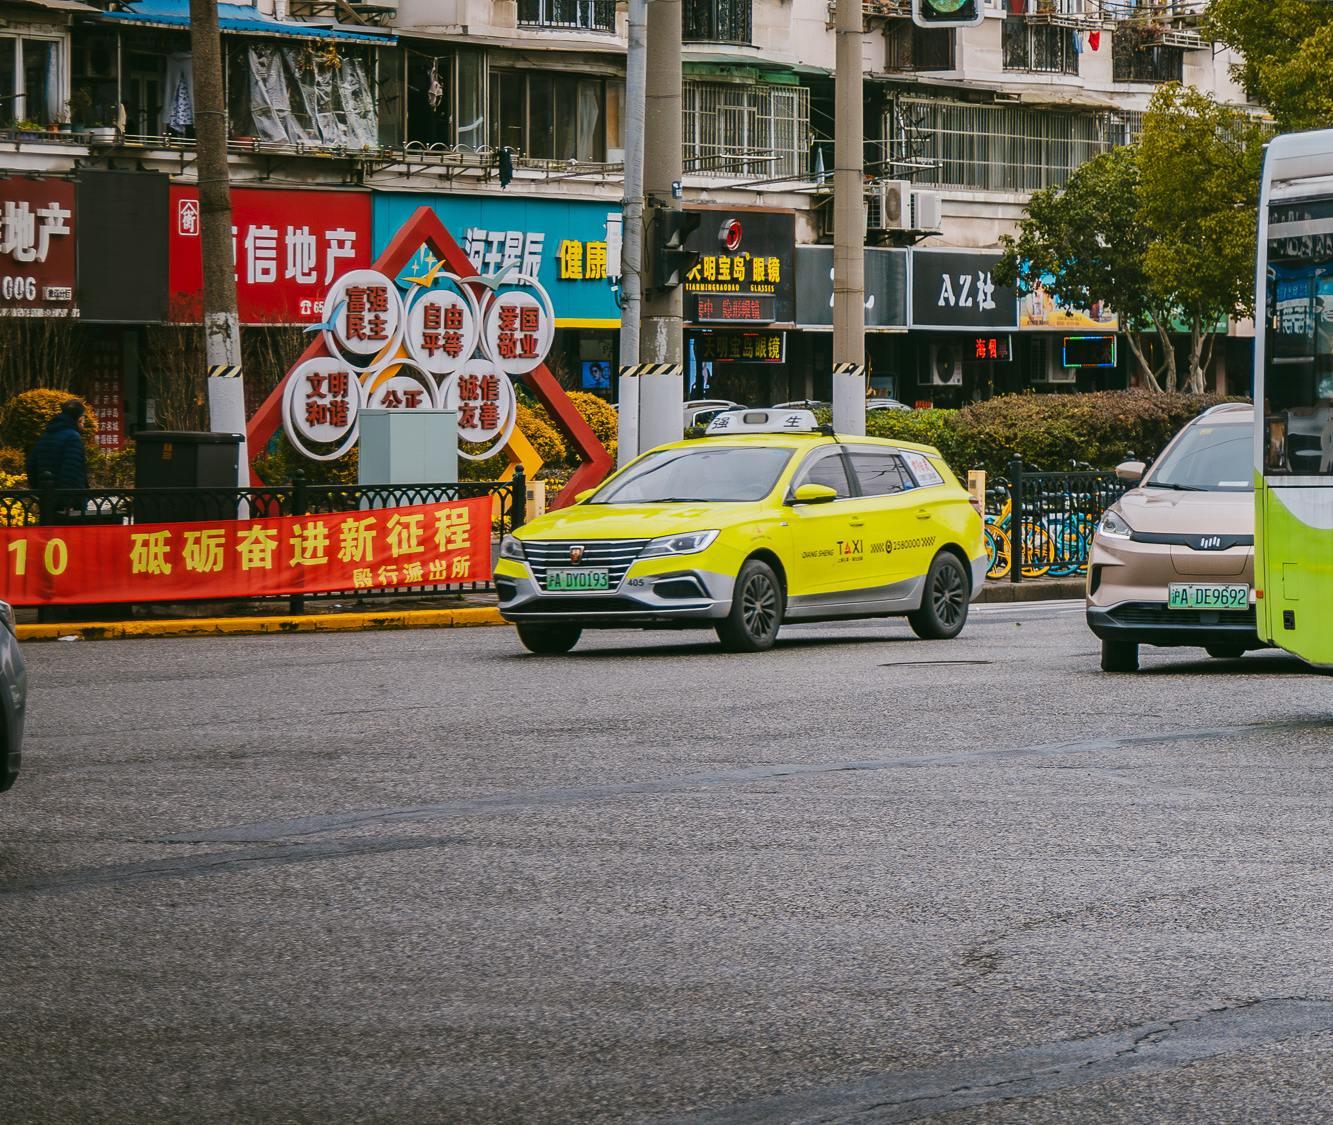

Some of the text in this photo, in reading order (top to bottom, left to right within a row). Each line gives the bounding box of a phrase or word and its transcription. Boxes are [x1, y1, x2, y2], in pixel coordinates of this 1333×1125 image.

[0, 201, 72, 262] 地产
[231, 224, 357, 286] 信地产
[346, 286, 389, 312] 富强
[750, 284, 775, 293] GLASSES
[346, 313, 389, 340] 民主
[423, 303, 464, 329] 自由
[498, 305, 540, 332] 爱国
[421, 332, 465, 358] 平等
[498, 333, 539, 358] 敬业
[704, 335, 781, 359] 天明宝岛眼镜
[306, 372, 349, 398] 文明
[458, 375, 501, 401] 诚信
[381, 390, 424, 409] 公正
[305, 400, 349, 426] 和谐
[458, 403, 501, 429] 友善
[712, 415, 802, 430] 强 生
[130, 506, 471, 575] 砥砺奋进新征程
[837, 539, 863, 555] TAXI
[353, 554, 471, 589] 殷行派出所
[627, 578, 645, 587] 405
